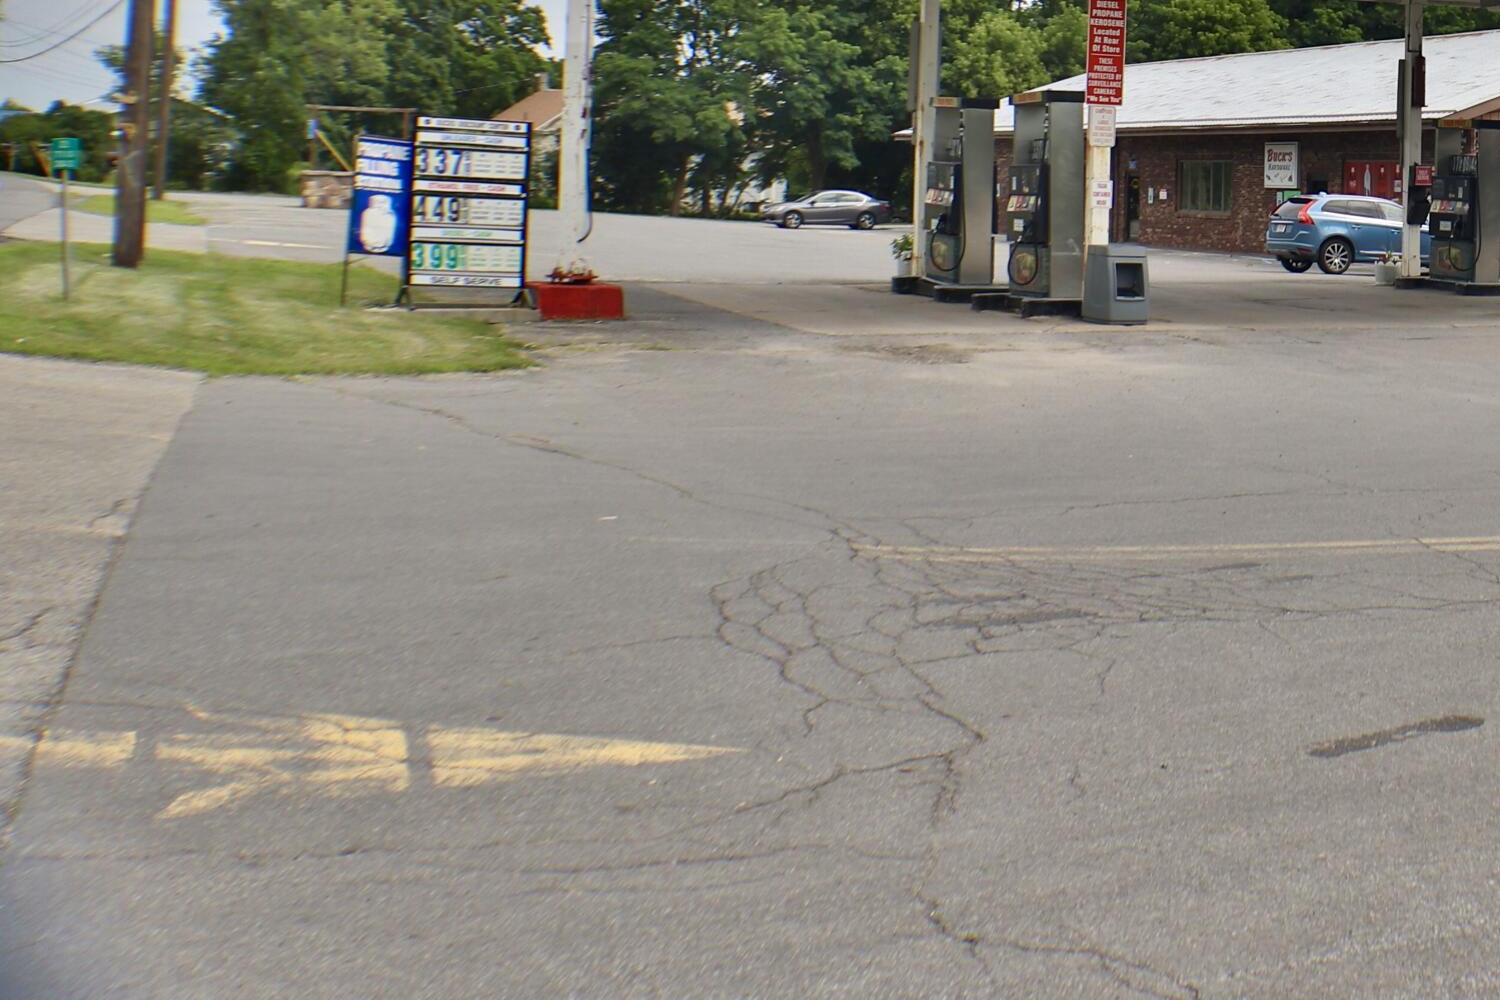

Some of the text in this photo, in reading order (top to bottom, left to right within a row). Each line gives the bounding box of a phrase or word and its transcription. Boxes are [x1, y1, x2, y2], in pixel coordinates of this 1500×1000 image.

[1096, 0, 1119, 9] DIESEL
[1091, 9, 1123, 18] PROPANE
[1090, 18, 1125, 27] KEROSENE
[1093, 27, 1121, 36] Located
[1103, 36, 1120, 44] Rear
[1092, 44, 1121, 53] Of Store
[1088, 72, 1115, 80] PROTECTED
[1093, 87, 1116, 95] CAMERAS
[416, 149, 463, 175] 337
[411, 243, 459, 270] 399
[431, 276, 502, 286] SELF SERVE
